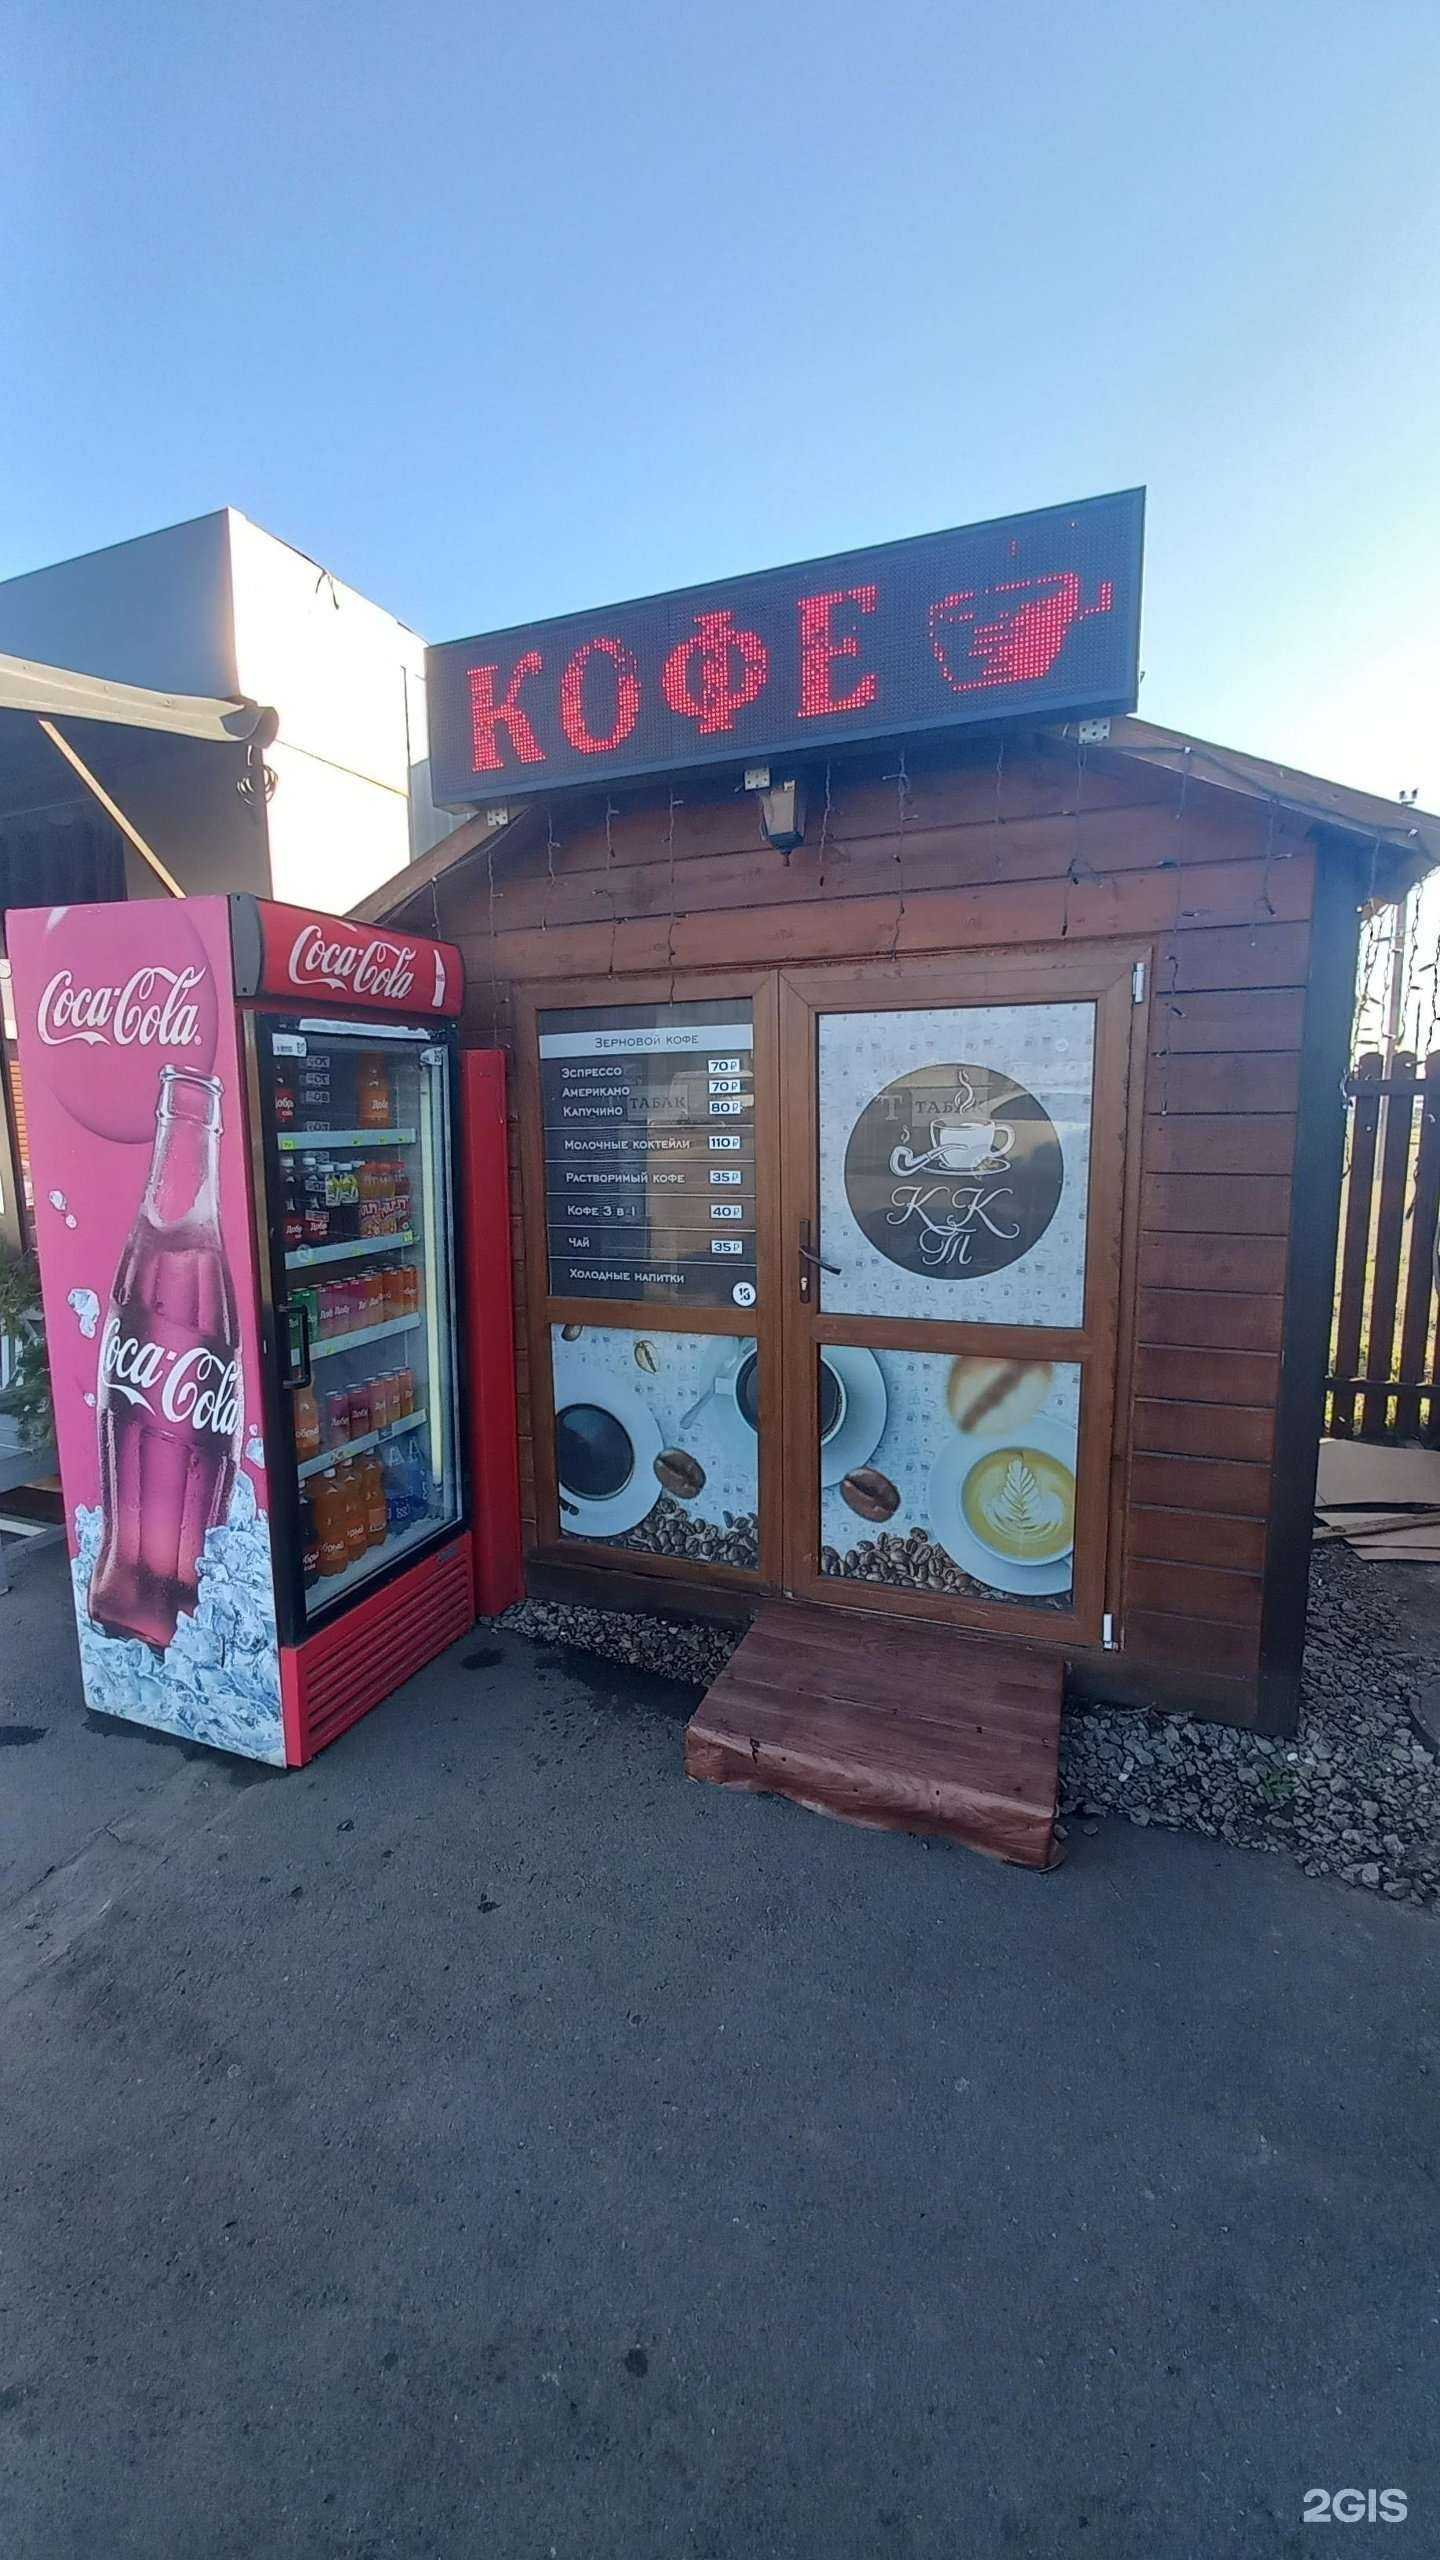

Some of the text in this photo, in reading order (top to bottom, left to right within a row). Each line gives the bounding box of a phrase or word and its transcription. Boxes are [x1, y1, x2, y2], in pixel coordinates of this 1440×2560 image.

[465, 585, 878, 774] КОФЕ
[289, 925, 416, 999] Coca-Cola
[38, 966, 207, 1046] Coca-Cola
[602, 1206, 612, 1216] 3
[102, 1318, 239, 1436] Coca-Cola
